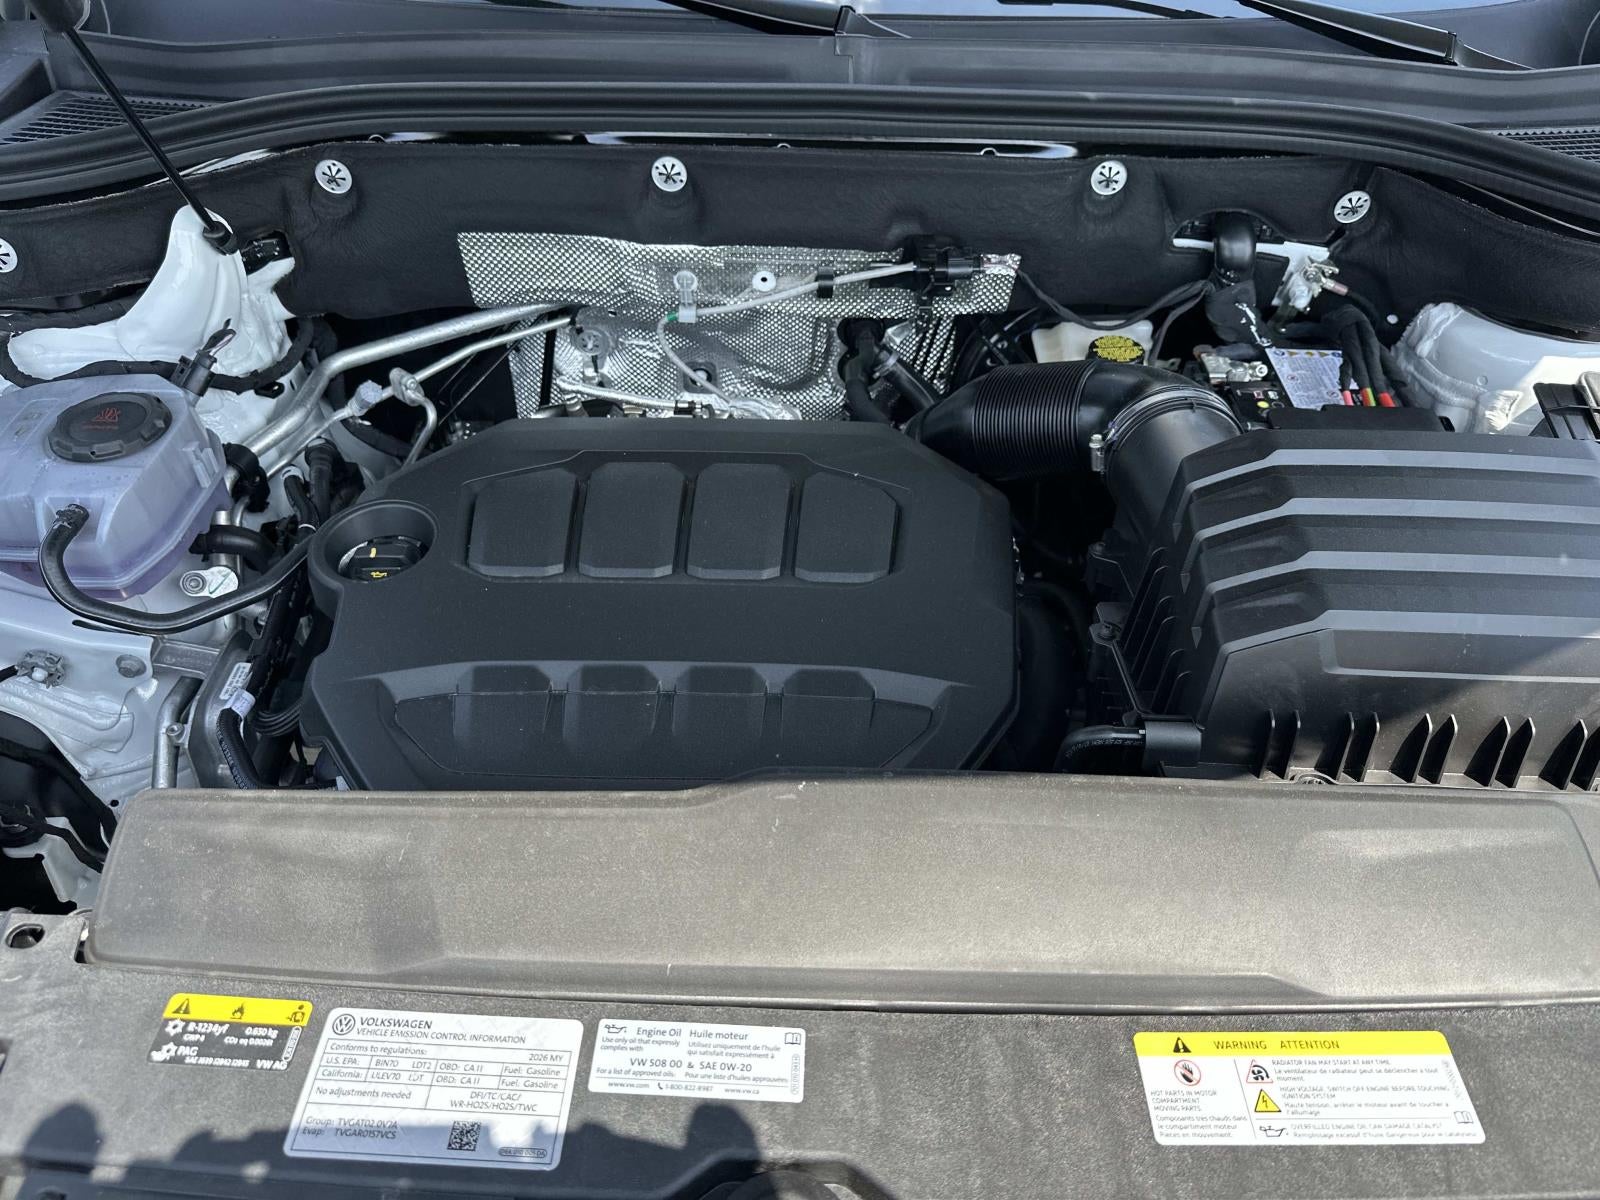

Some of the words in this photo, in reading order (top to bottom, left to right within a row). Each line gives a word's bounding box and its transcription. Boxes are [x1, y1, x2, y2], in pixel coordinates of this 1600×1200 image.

[360, 1017, 433, 1029] VOLKSWAGEN
[268, 1029, 279, 1038] kg
[357, 1028, 389, 1037] VEHICLE
[391, 1030, 429, 1039] EMISSION
[431, 1032, 468, 1041] CONTROL
[469, 1034, 527, 1044] INFORMATION
[637, 1027, 668, 1039] Engine
[669, 1028, 682, 1037] Oil
[690, 1029, 714, 1039] Huile
[716, 1032, 749, 1040] moteur
[615, 1037, 628, 1045] only
[652, 1039, 681, 1047] expressly
[1213, 1040, 1268, 1050] WARNING
[1280, 1040, 1341, 1050] ATTENTION
[177, 1046, 199, 1056] PAG
[331, 1043, 368, 1053] Conforms
[370, 1045, 379, 1053] to
[380, 1045, 428, 1055] regulations:
[600, 1044, 628, 1052] complies
[713, 1043, 752, 1052] uniquement
[326, 1056, 342, 1065] U.S.
[529, 1053, 548, 1062] 2026
[256, 1060, 274, 1069] VW
[272, 1061, 288, 1070] AG
[375, 1059, 399, 1067] BIN70
[412, 1061, 432, 1070] LDT2
[440, 1063, 460, 1071] OBD:
[464, 1064, 476, 1072] CA
[630, 1058, 649, 1067] VW
[649, 1058, 668, 1068] 508
[669, 1059, 683, 1069] 00
[699, 1061, 718, 1071] SAE
[720, 1062, 753, 1072] 0W-20
[322, 1069, 363, 1079] California:
[504, 1066, 523, 1075] Fuel:
[526, 1068, 561, 1076] Gasoline
[632, 1070, 662, 1078] approved
[436, 1075, 457, 1083] OBD:
[460, 1077, 473, 1085] CA
[501, 1079, 520, 1087] Fuel:
[524, 1080, 559, 1089] Gasoline
[316, 1087, 328, 1095] No
[329, 1087, 379, 1098] adjustments
[381, 1090, 412, 1099] needed
[306, 1116, 335, 1126] Group:
[303, 1127, 325, 1137] Evap:
